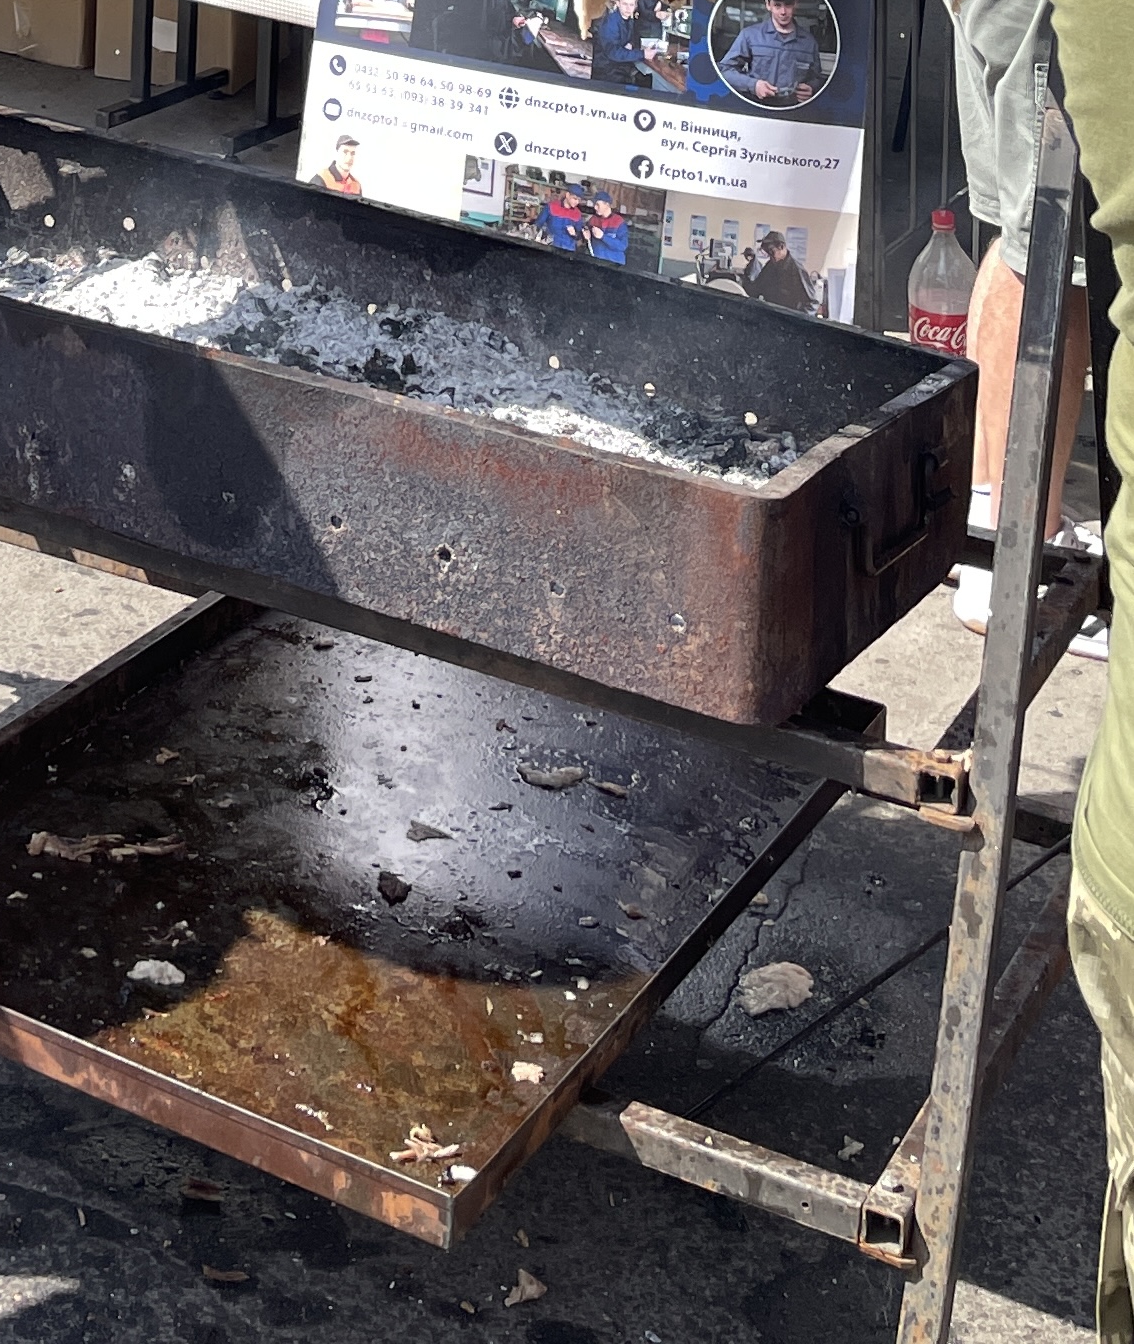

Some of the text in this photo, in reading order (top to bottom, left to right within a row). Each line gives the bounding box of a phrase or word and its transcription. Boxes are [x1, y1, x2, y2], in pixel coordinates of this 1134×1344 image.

[524, 95, 627, 122] dnzcpto1.vn.ua
[662, 119, 742, 142] м. Вінниця,
[524, 140, 587, 162] dnzcpto1
[661, 137, 689, 152] вул.
[692, 140, 737, 159] Сергія
[659, 162, 748, 189] fcpto1.vn.ua
